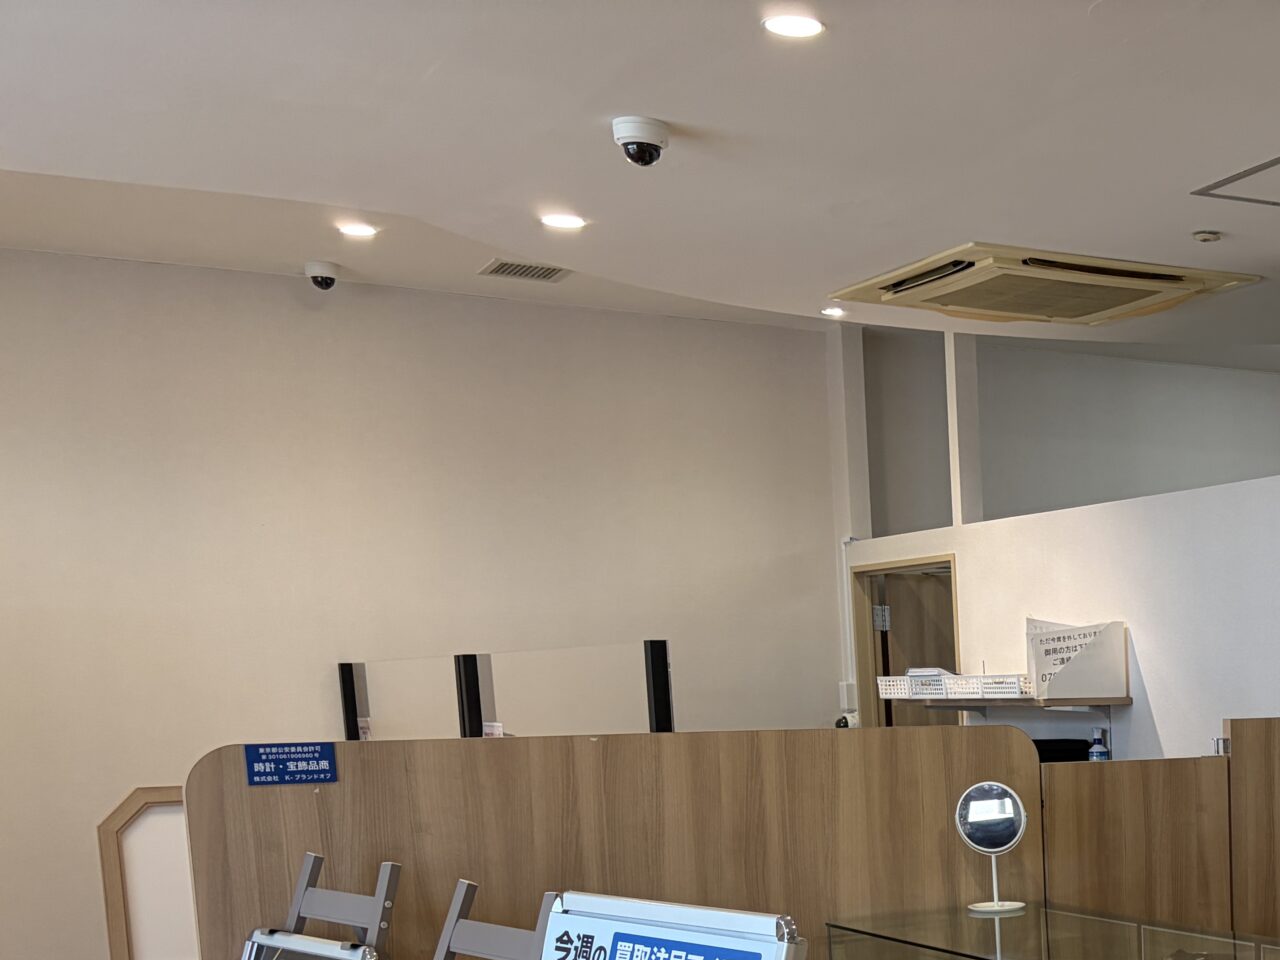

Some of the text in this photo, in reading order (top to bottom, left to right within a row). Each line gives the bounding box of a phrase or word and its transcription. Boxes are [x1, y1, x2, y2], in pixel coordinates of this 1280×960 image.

[1041, 672, 1057, 683] 07
[253, 760, 329, 773] 時計・宝飾品商
